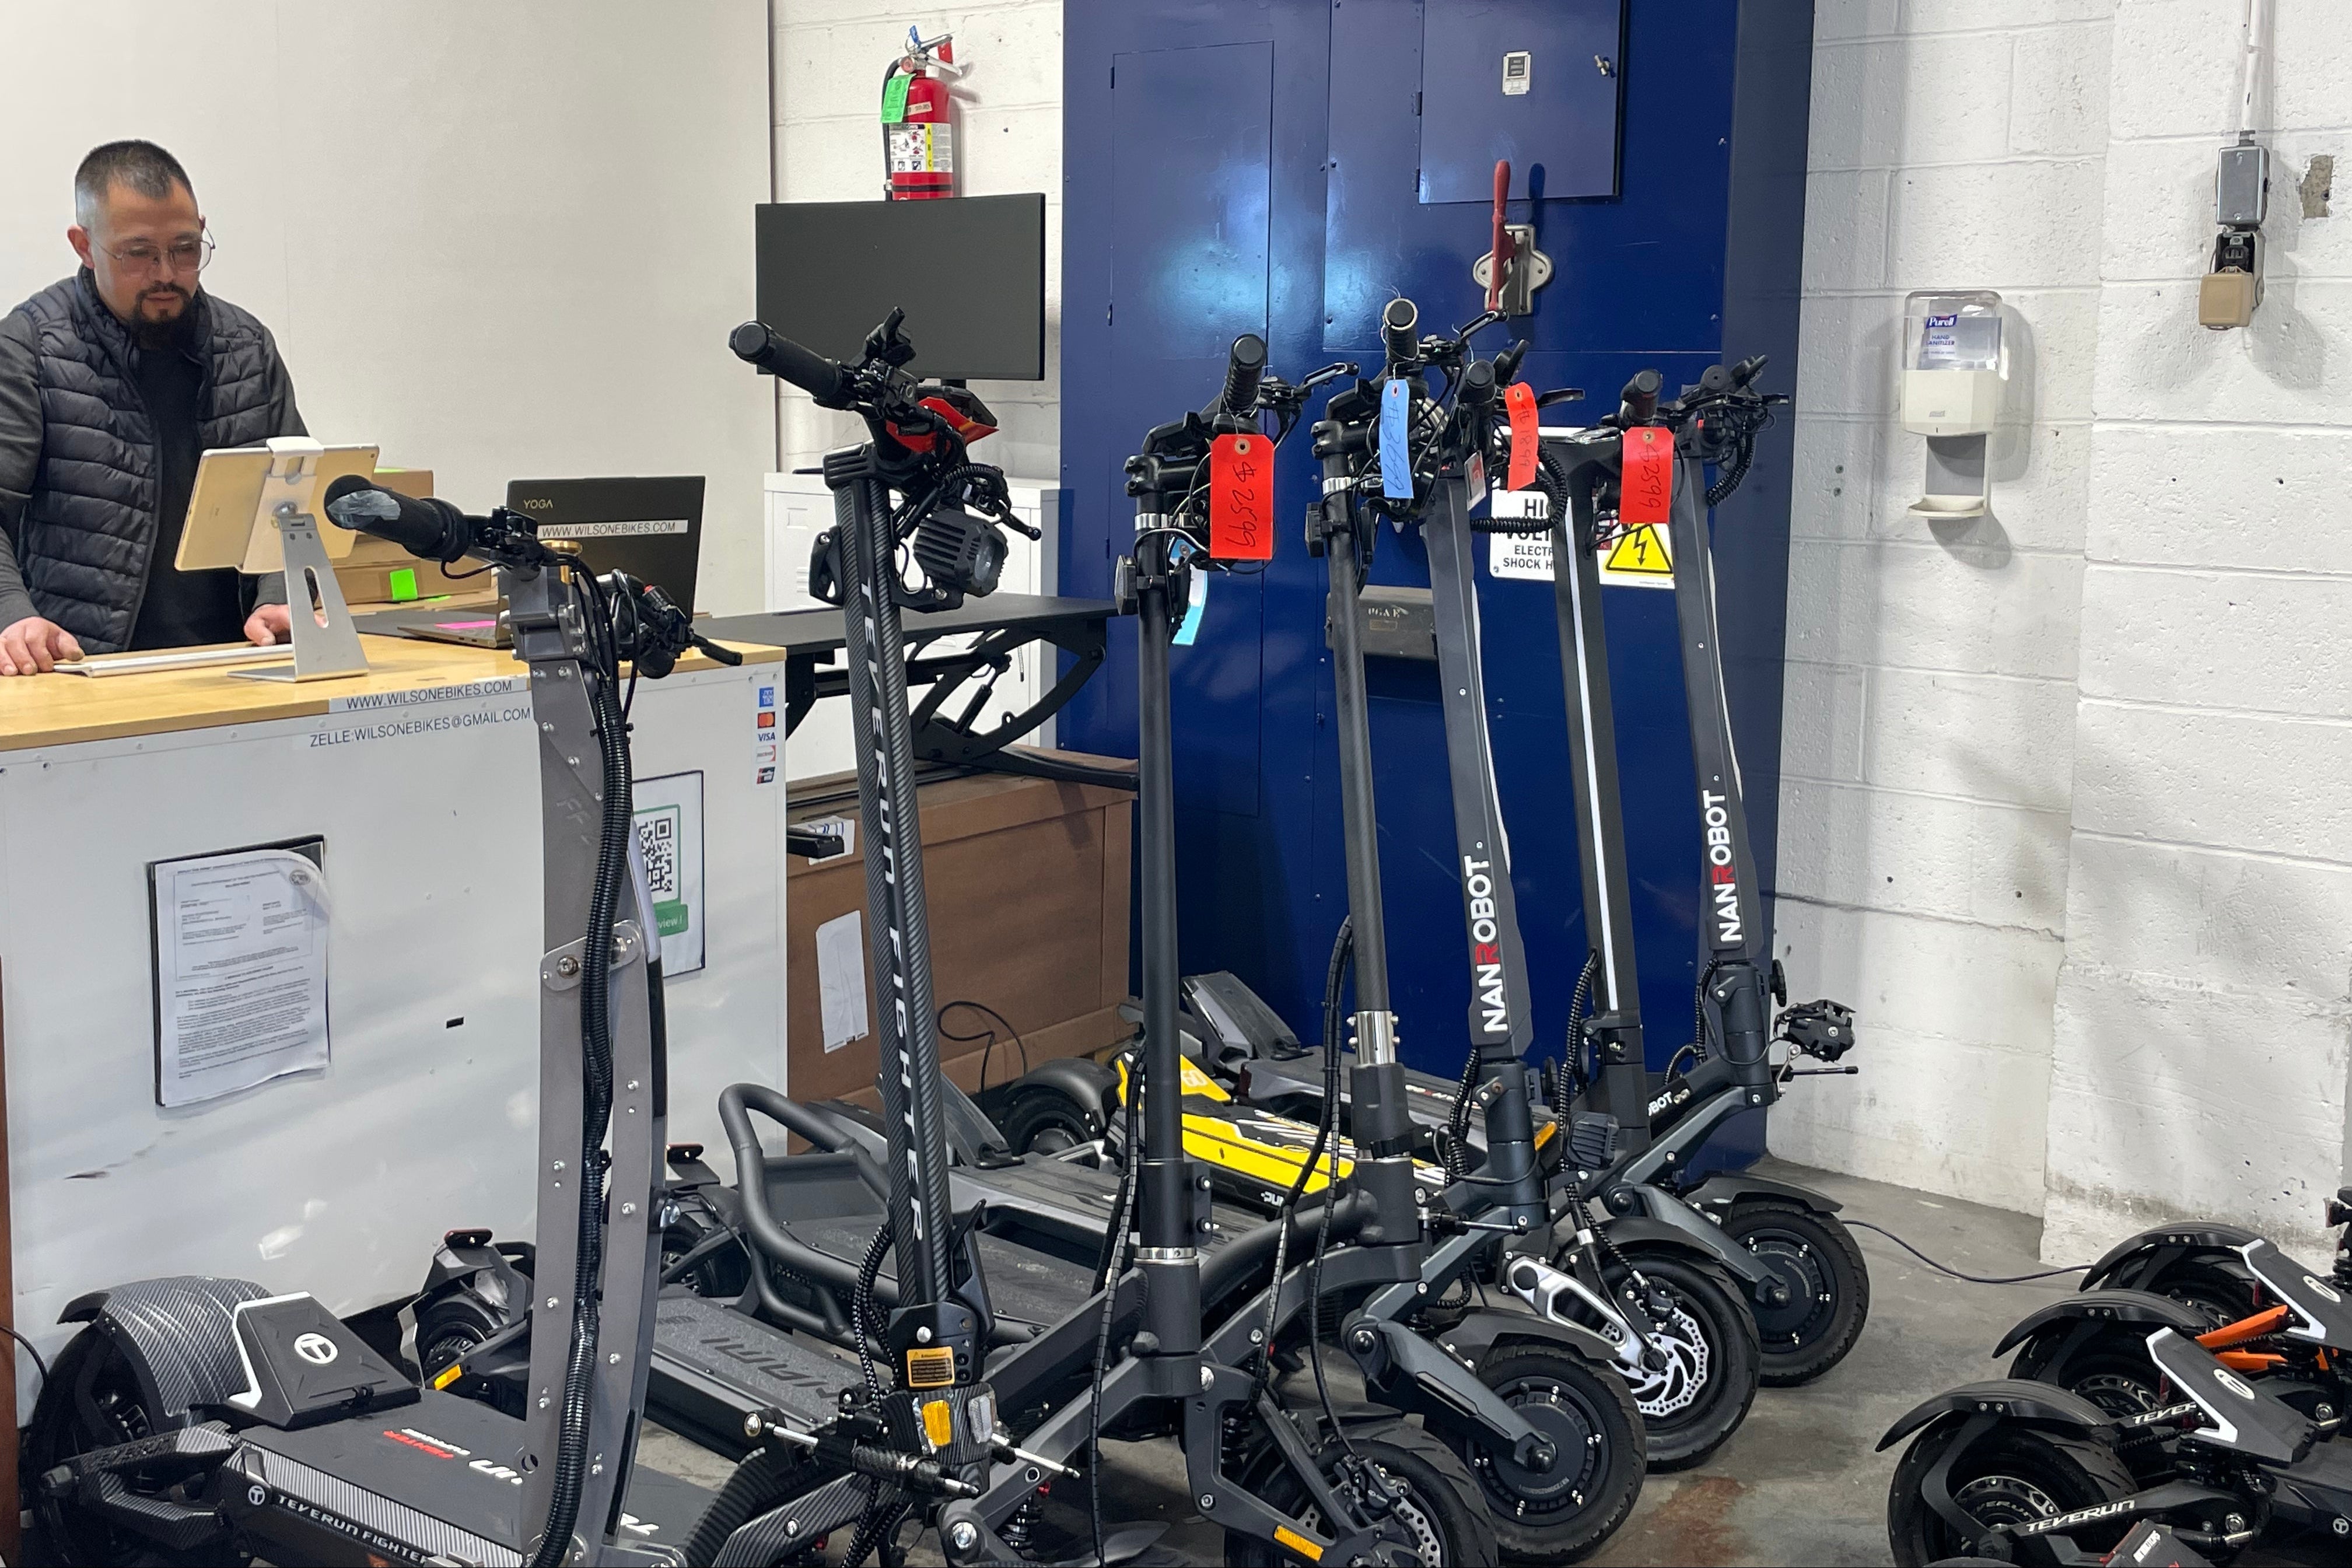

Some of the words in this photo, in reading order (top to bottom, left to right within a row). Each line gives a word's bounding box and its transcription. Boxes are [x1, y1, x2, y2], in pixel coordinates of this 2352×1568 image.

[524, 499, 553, 509] YOGA
[542, 522, 676, 537] WWW.WILSONEBIKES.COM
[1503, 557, 1541, 569] SHOCK
[346, 680, 512, 710] WWW.WILSONEBIKES.COM
[310, 707, 531, 747] ZELLE:WILSONEBIKES@GMAIL.COM
[758, 732, 776, 742] VISA
[860, 583, 895, 885] TEVERUN
[1703, 790, 1742, 942] NANROBOT
[1464, 856, 1508, 1032] NANROBOT
[889, 926, 922, 1242] FIGHTER
[279, 1496, 358, 1535] TEVERUN
[2027, 1500, 2135, 1532] TEVERUN
